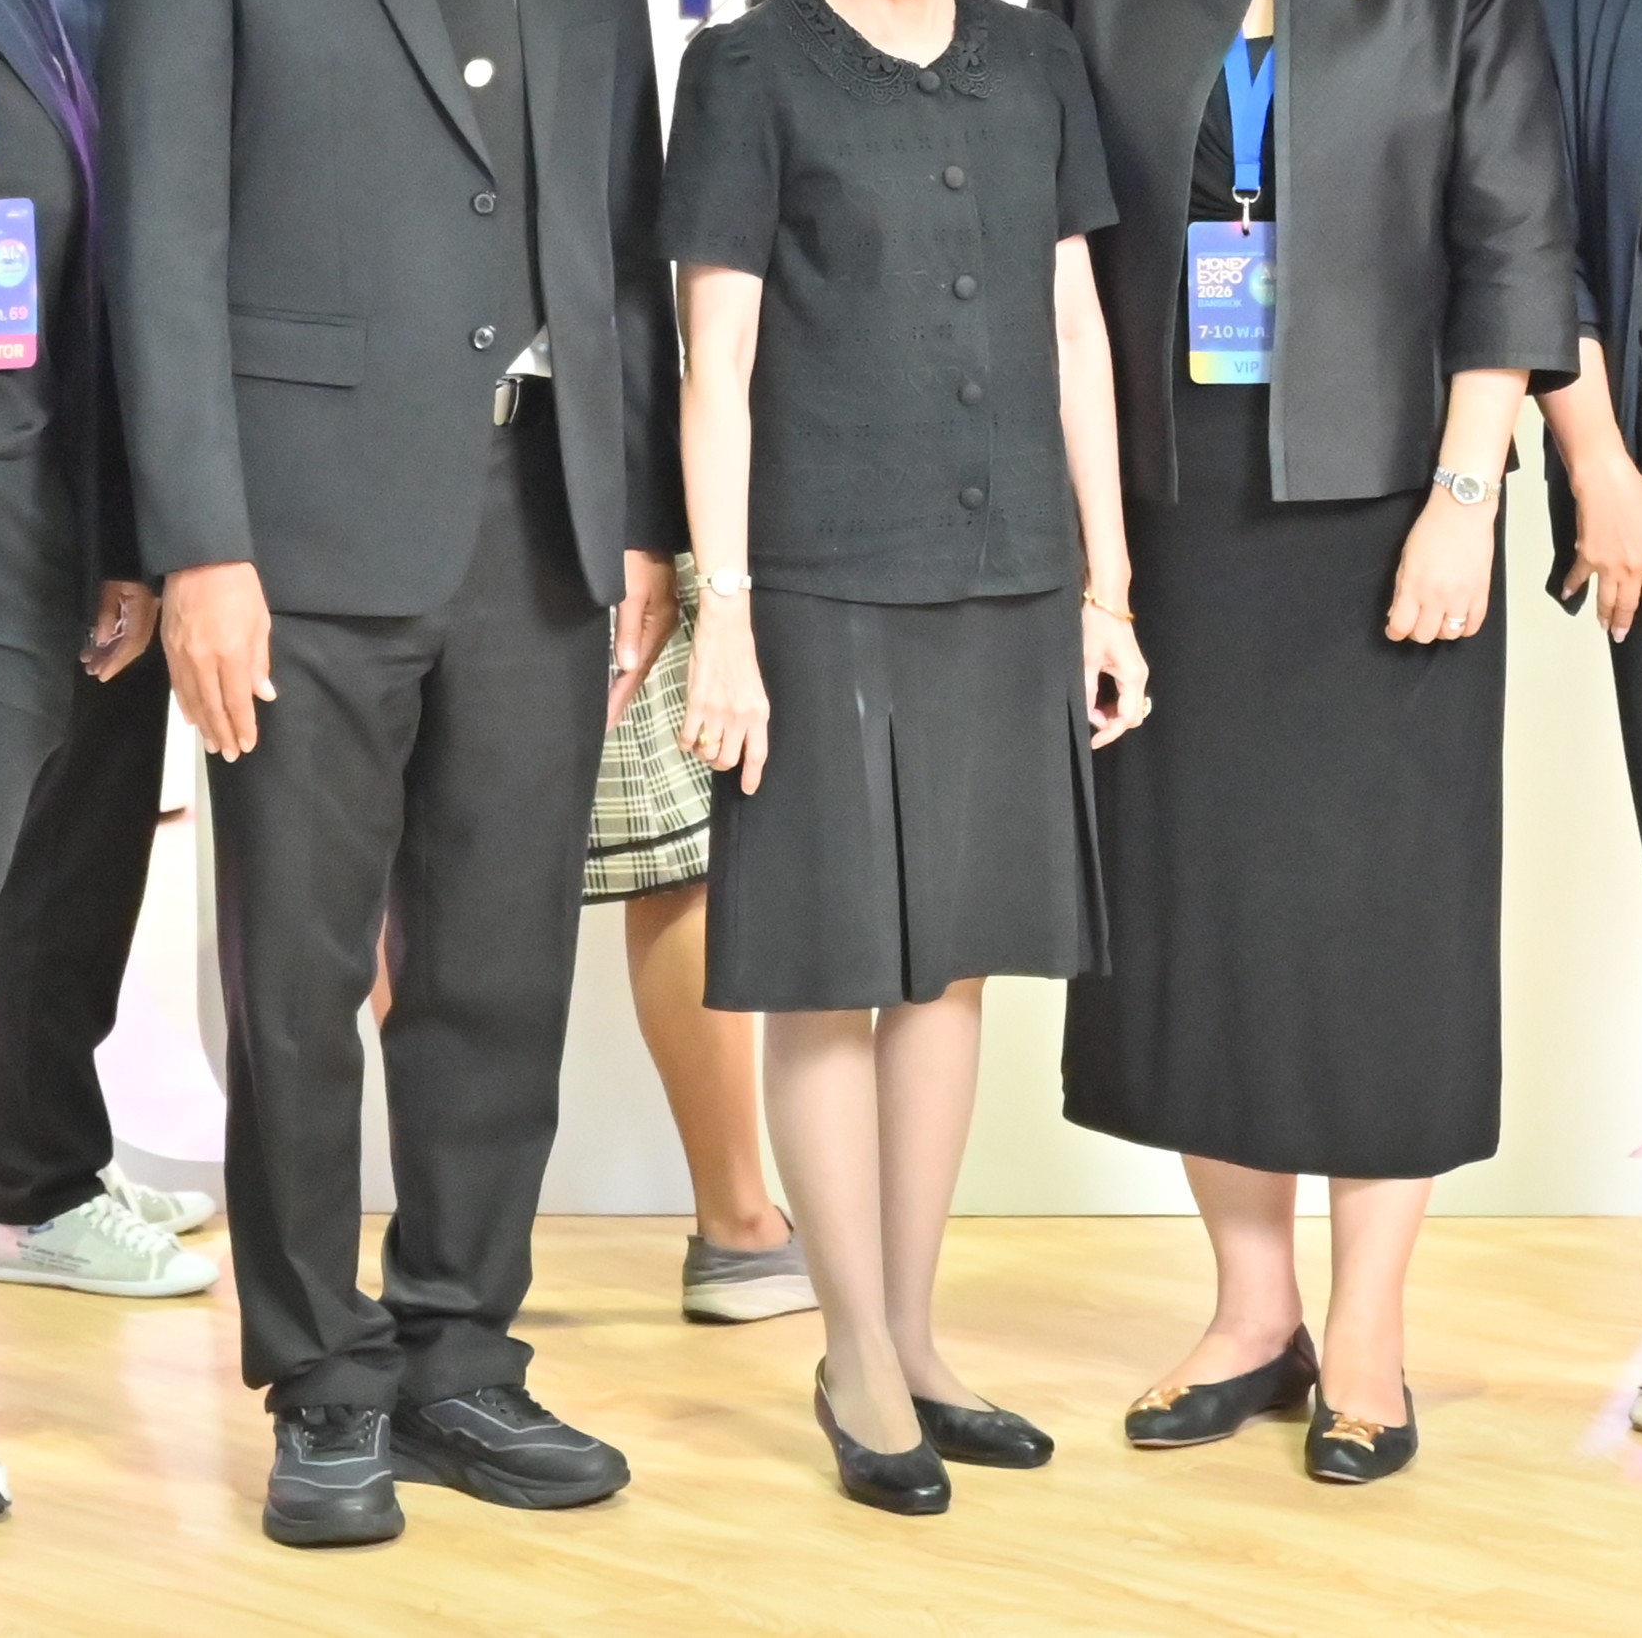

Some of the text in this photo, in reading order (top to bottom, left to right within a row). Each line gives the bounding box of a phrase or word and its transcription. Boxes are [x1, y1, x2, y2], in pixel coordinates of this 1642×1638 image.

[1196, 257, 1252, 271] MONEY
[1196, 270, 1244, 284] EXPO
[1197, 285, 1234, 298] 2026
[8, 306, 29, 321] 69
[1234, 362, 1260, 374] VIP
